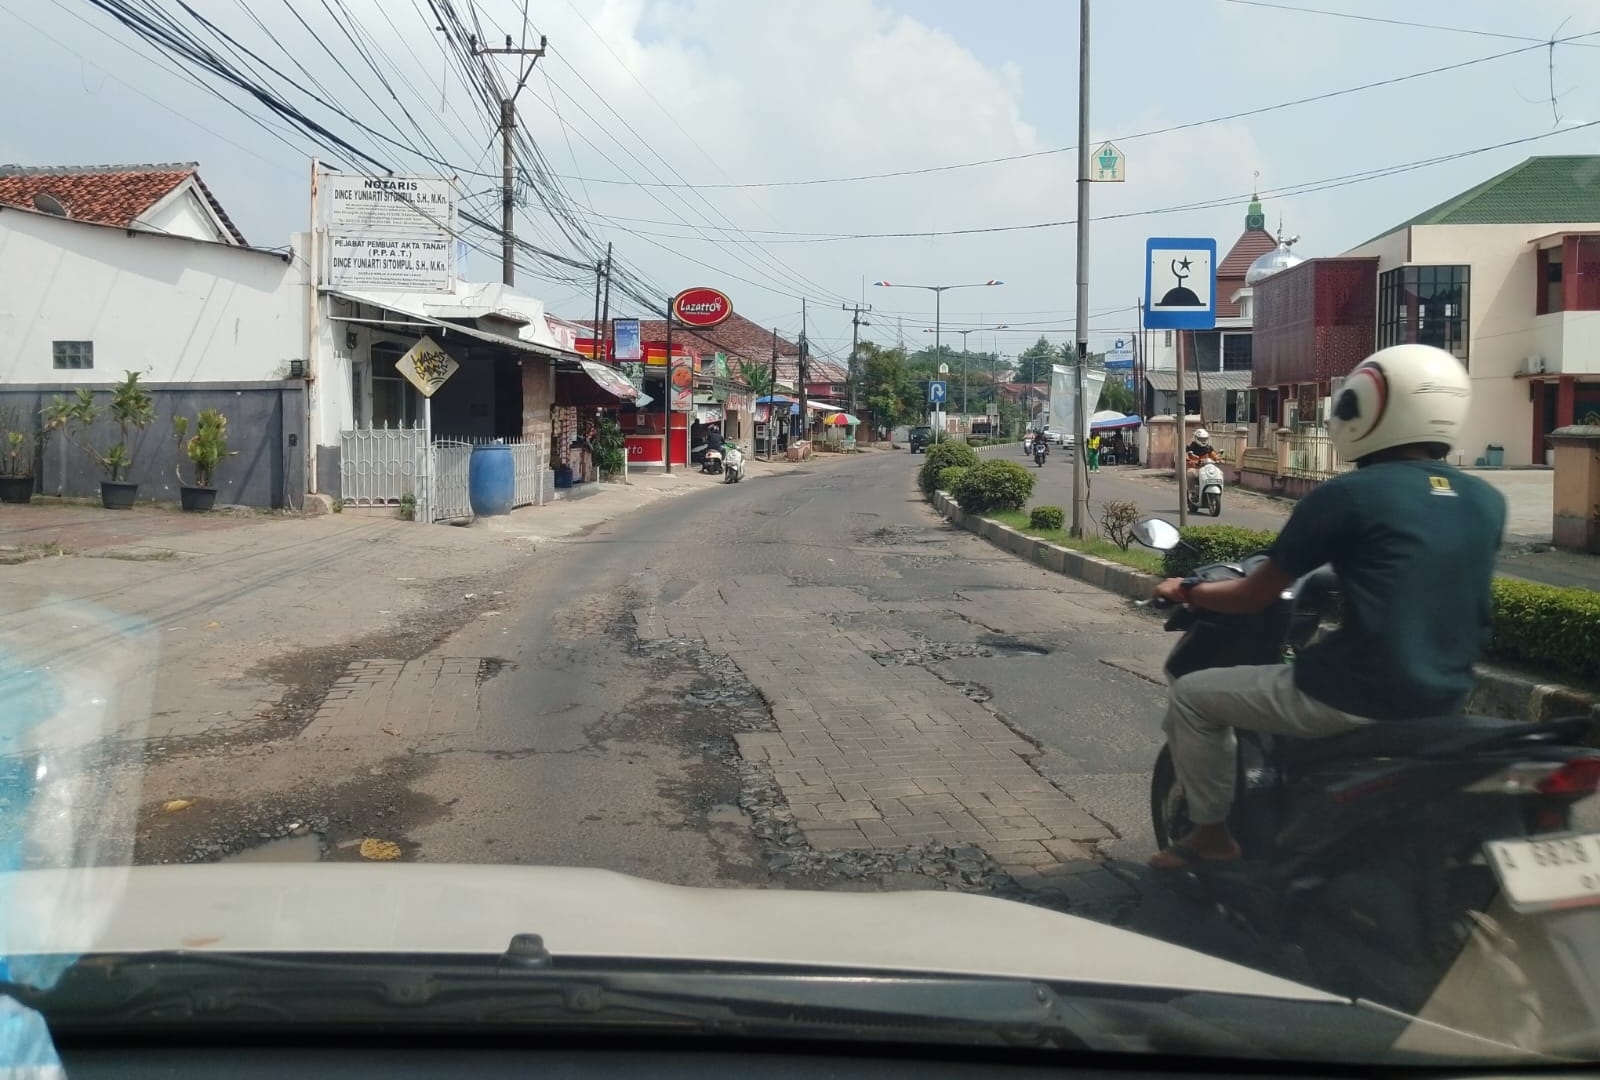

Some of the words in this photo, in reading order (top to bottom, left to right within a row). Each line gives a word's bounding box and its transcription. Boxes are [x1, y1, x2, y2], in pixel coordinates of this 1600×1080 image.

[364, 180, 418, 191] NOTARIS
[334, 189, 353, 200] DINCE
[353, 190, 383, 201] YUNIARTI
[334, 239, 365, 248] PEJABAT
[367, 240, 399, 249] PEMBUAT
[401, 242, 420, 250] AKTA
[423, 242, 446, 250] TANAH
[333, 257, 352, 268] DINCE
[353, 258, 382, 269] YUNIARTI
[680, 299, 716, 312] Lazatto
